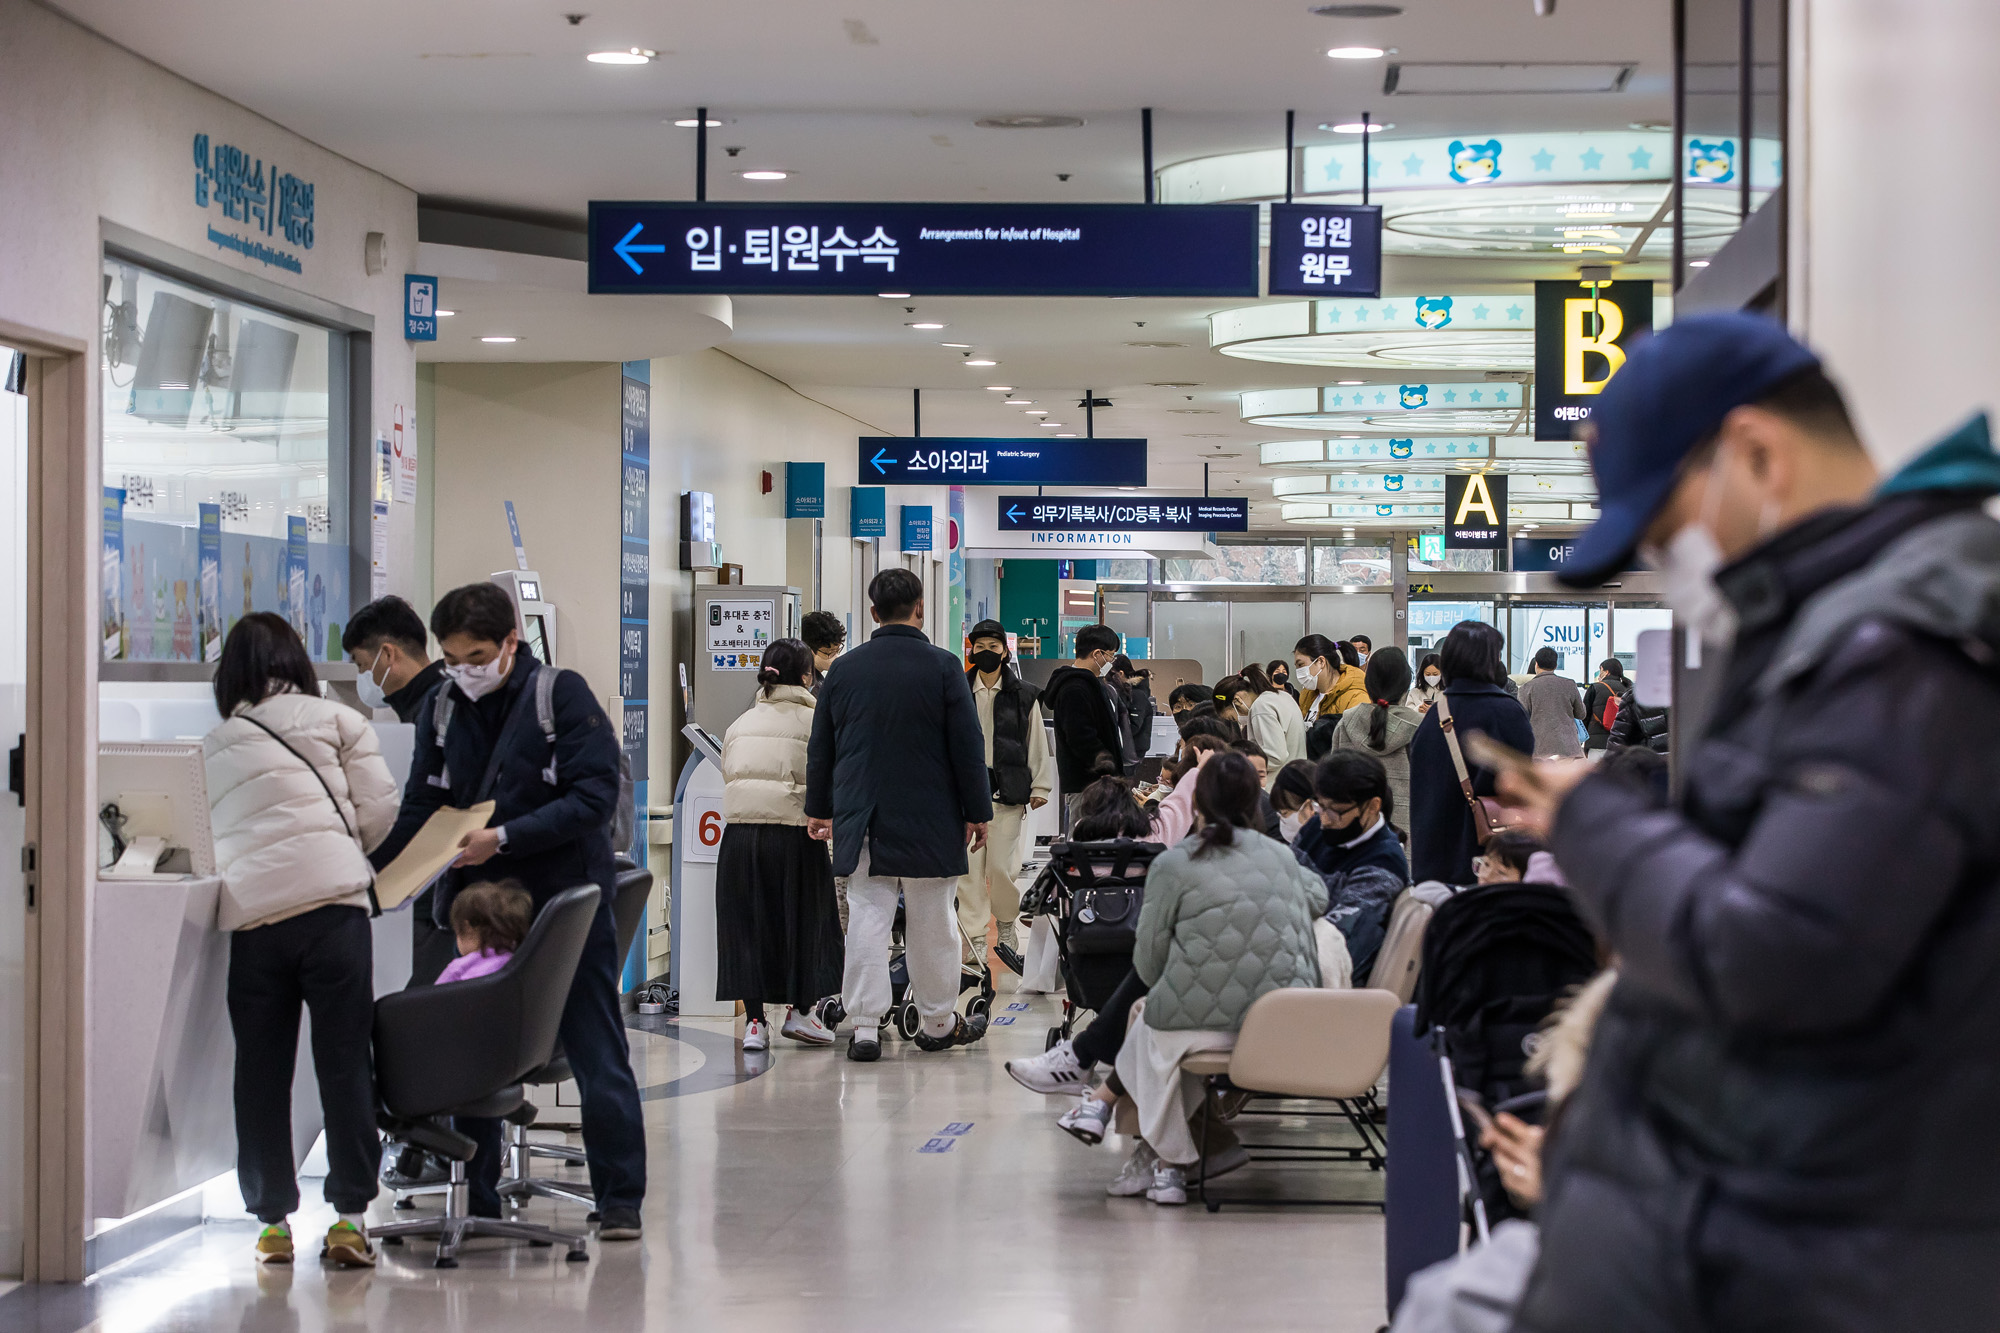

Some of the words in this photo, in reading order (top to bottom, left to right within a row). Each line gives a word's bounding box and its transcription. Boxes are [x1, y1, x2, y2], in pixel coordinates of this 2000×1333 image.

[920, 227, 983, 242] Arrangements
[985, 227, 1000, 240] for
[1000, 227, 1029, 242] in/out
[1030, 228, 1041, 240] of
[1042, 228, 1080, 243] Hospital
[1300, 216, 1353, 247] 입원
[1299, 252, 1353, 285] 원무
[409, 320, 433, 334] 정수기
[1564, 298, 1627, 395] B
[907, 447, 989, 475] 소아외과
[1020, 450, 1040, 458] Surgery
[1453, 475, 1499, 525] A
[1032, 533, 1132, 544] INFORMATION
[1455, 531, 1487, 539] 어린이병원
[723, 610, 750, 621] 휴대폰
[753, 610, 771, 621] 충전
[737, 624, 744, 633] &
[713, 640, 751, 648] 보조배터리
[698, 811, 722, 846] 6
